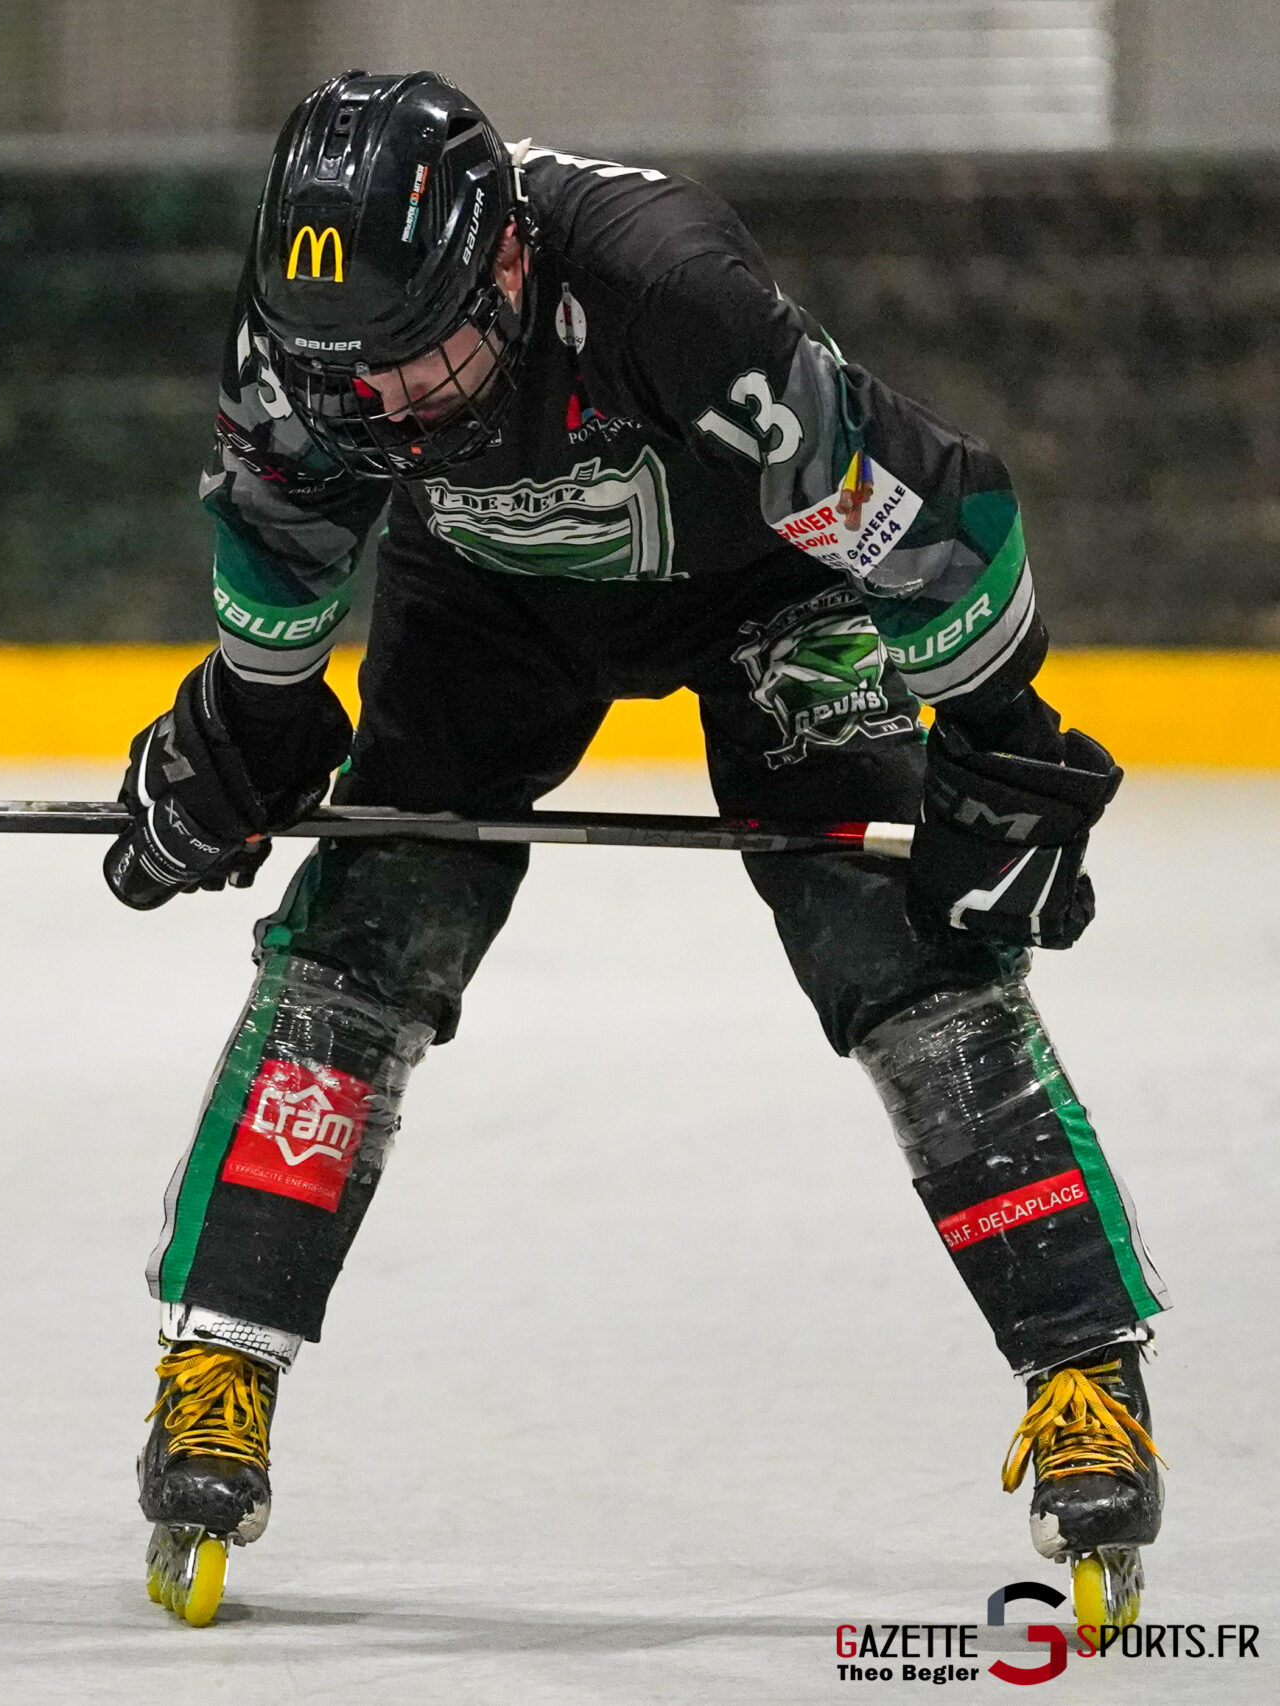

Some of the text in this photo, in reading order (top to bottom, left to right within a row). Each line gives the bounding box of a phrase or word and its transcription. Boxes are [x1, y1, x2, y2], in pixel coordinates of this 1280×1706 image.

[462, 187, 485, 266] BAUER
[294, 337, 362, 351] BAUER
[693, 369, 805, 468] 13
[428, 486, 586, 514] T-DE-METZ
[886, 593, 993, 665] AUER
[978, 1183, 1084, 1233] DELAPLACE
